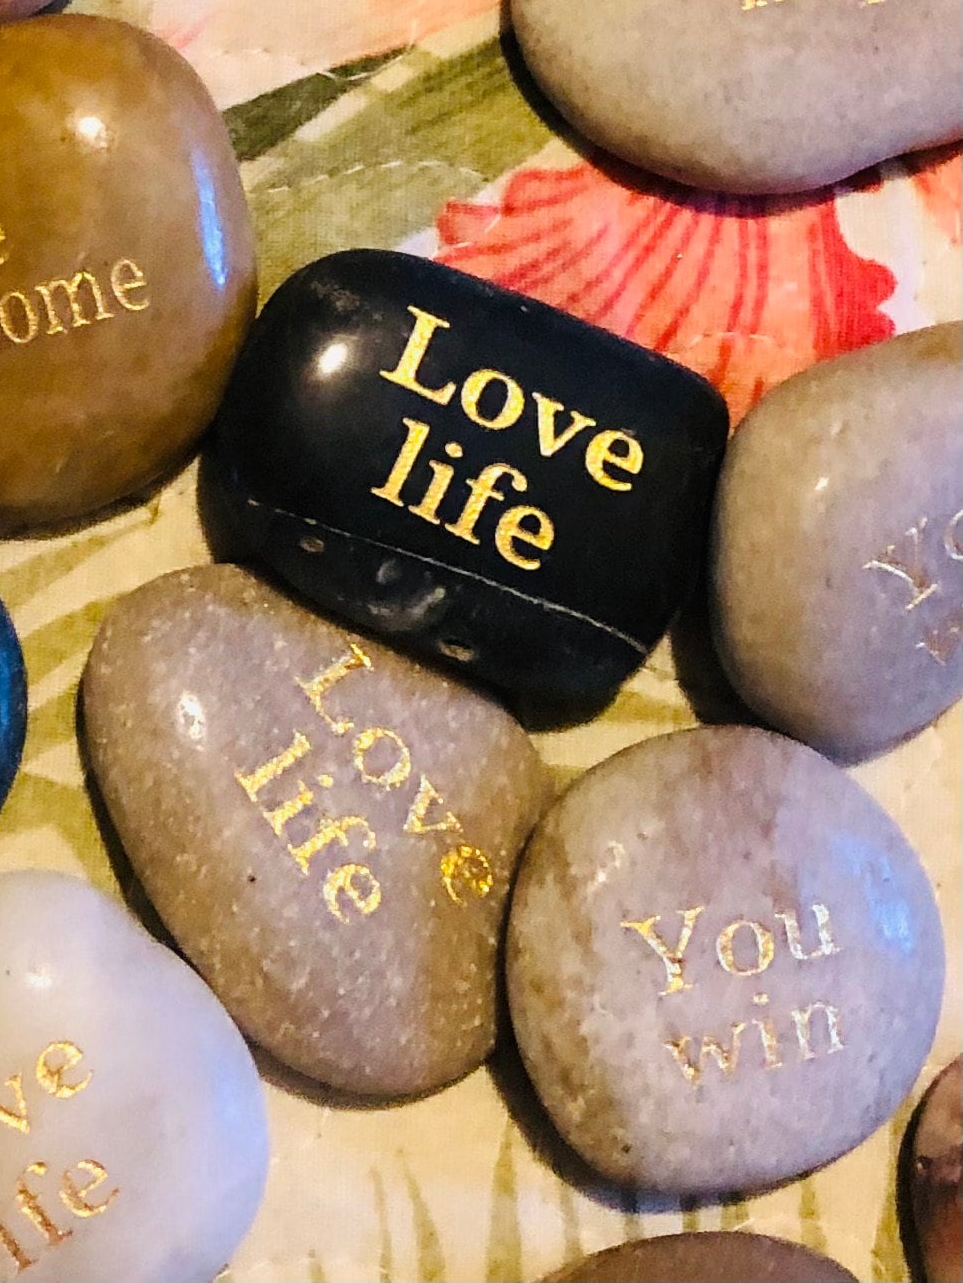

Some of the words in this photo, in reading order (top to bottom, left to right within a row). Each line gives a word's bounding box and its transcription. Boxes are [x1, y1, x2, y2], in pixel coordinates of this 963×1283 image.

[379, 305, 645, 492] Love
[370, 417, 555, 571] life
[235, 730, 382, 923] life
[296, 643, 494, 905] Love
[620, 903, 843, 996] You
[662, 993, 844, 1087] win
